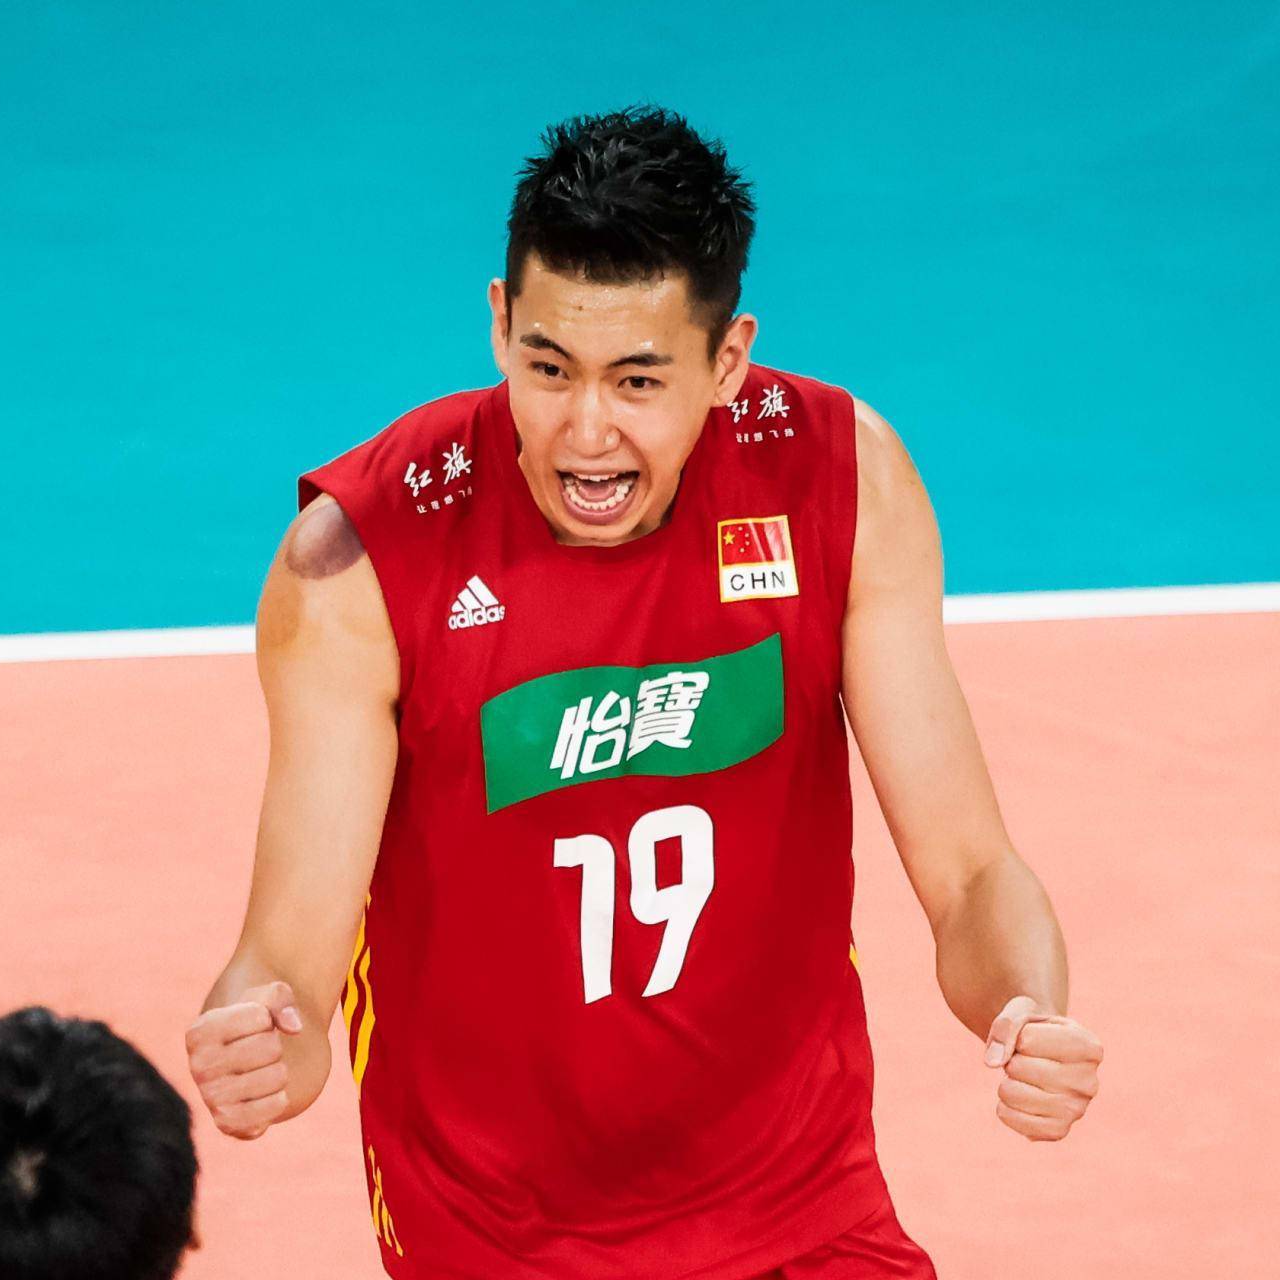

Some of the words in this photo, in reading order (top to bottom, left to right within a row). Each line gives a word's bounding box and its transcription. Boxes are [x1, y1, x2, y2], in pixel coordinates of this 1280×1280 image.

[403, 442, 473, 498] 红旗
[730, 570, 786, 592] CHN
[448, 605, 506, 631] adidas
[549, 671, 710, 780] 怡寶
[553, 804, 715, 1005] 19
